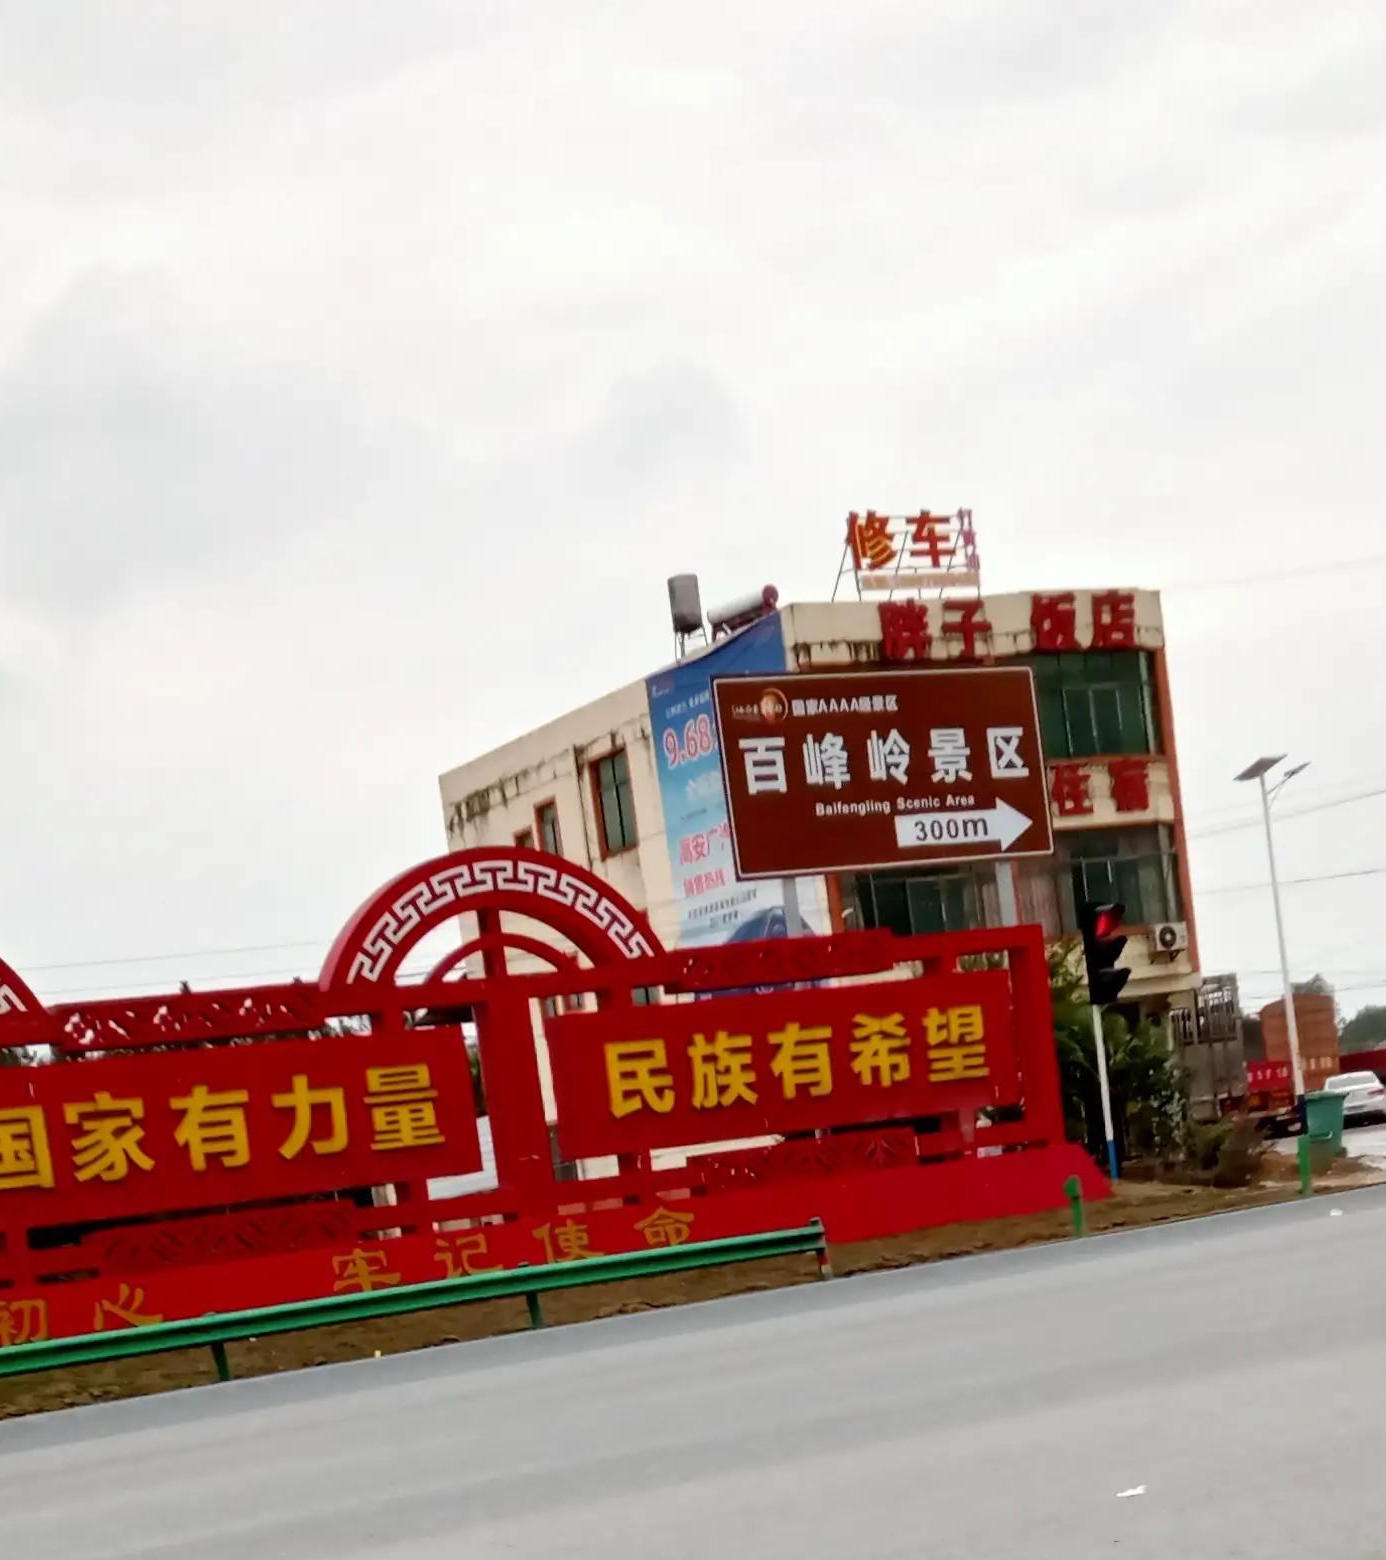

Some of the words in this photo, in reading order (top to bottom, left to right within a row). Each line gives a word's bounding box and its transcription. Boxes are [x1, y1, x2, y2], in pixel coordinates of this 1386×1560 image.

[845, 508, 956, 572] 修车
[663, 713, 719, 769] 9.68
[738, 726, 1030, 796] 百峰岭景区
[815, 800, 892, 817] Baifengling
[896, 796, 941, 810] Scenic
[945, 793, 975, 807] Area
[914, 817, 989, 841] 300m
[603, 1003, 991, 1120] 民族有希望
[332, 1206, 694, 1292] 牢记使命
